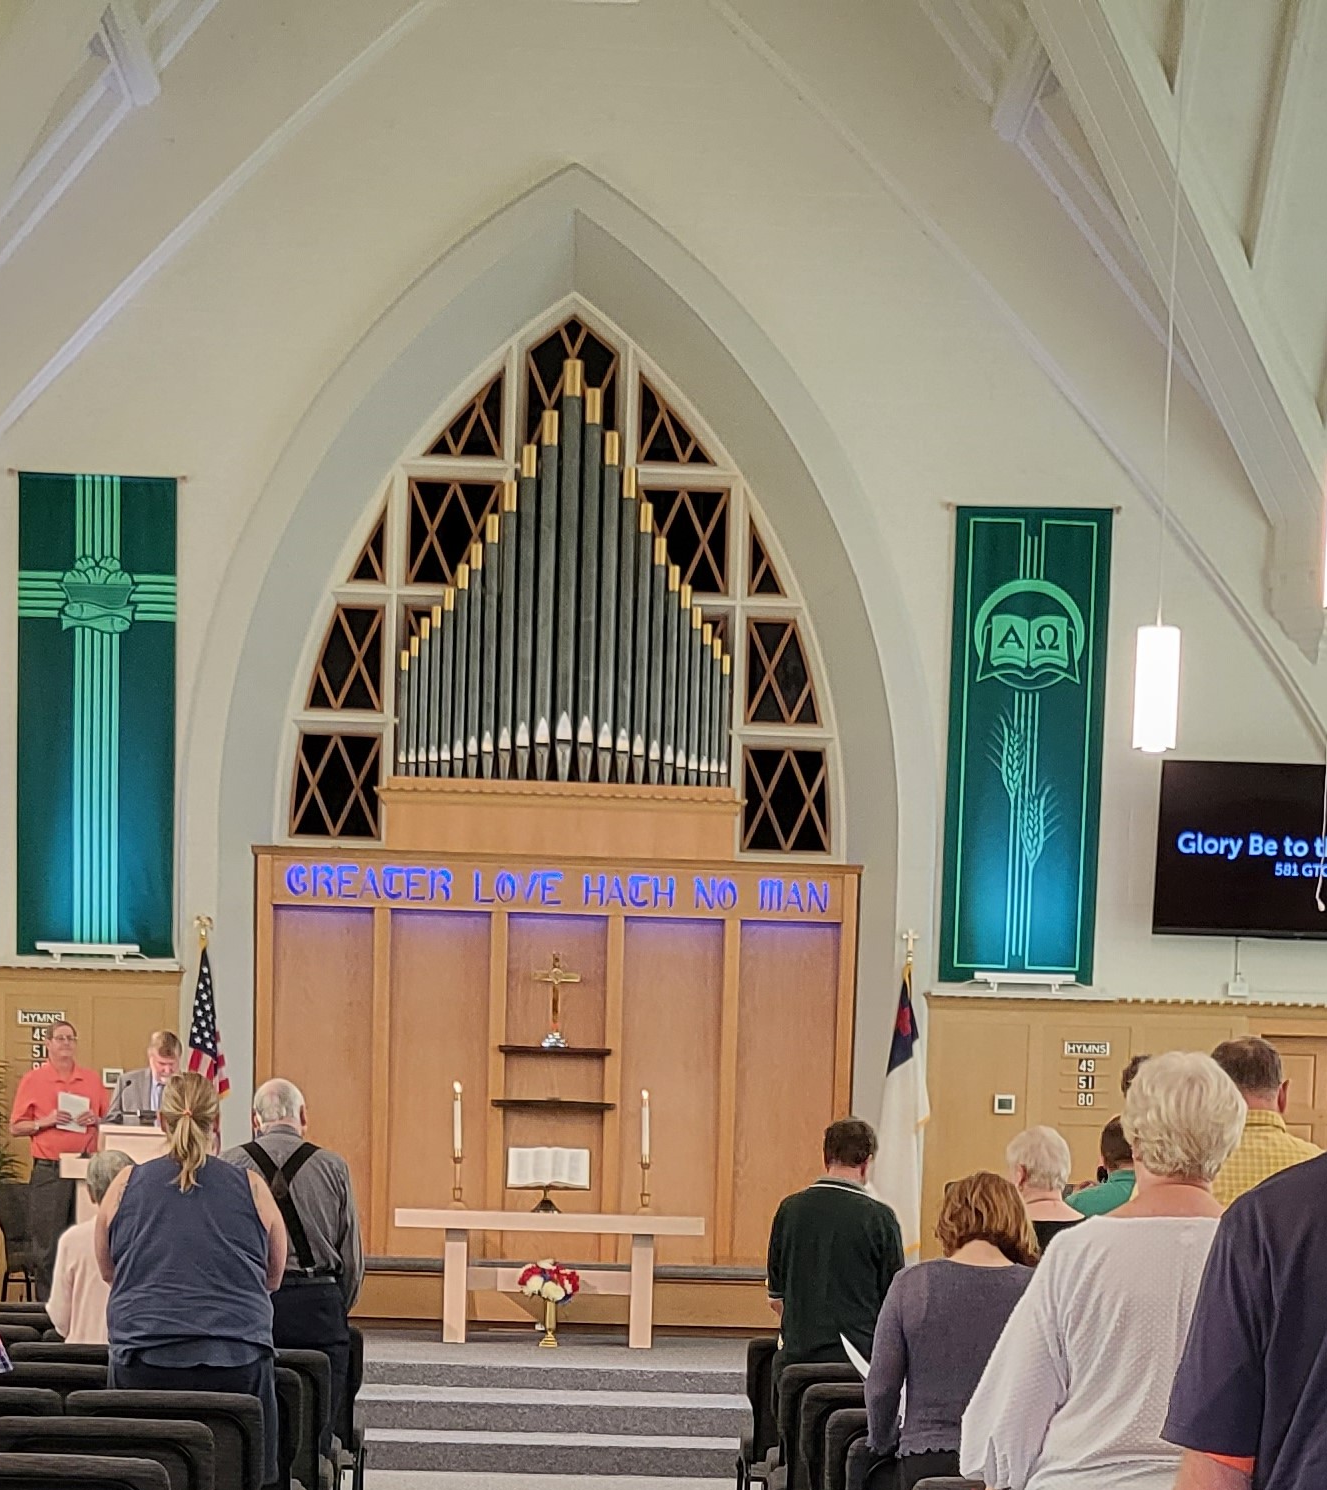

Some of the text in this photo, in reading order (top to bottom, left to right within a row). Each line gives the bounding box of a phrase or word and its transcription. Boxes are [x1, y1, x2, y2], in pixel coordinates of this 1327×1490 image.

[1034, 623, 1060, 651] Ω
[1177, 831, 1243, 860] Glory
[1248, 832, 1278, 856] Be
[1283, 835, 1309, 857] to
[1274, 861, 1299, 876] 581
[286, 864, 829, 913] GREATER LOVE HATH NO MAN
[22, 1013, 61, 1022] HYMNS
[33, 1045, 47, 1057] 51
[1067, 1044, 1106, 1053] HYMNS
[1079, 1060, 1095, 1072] 49
[1078, 1076, 1093, 1089] 51
[1078, 1093, 1093, 1105] 80
